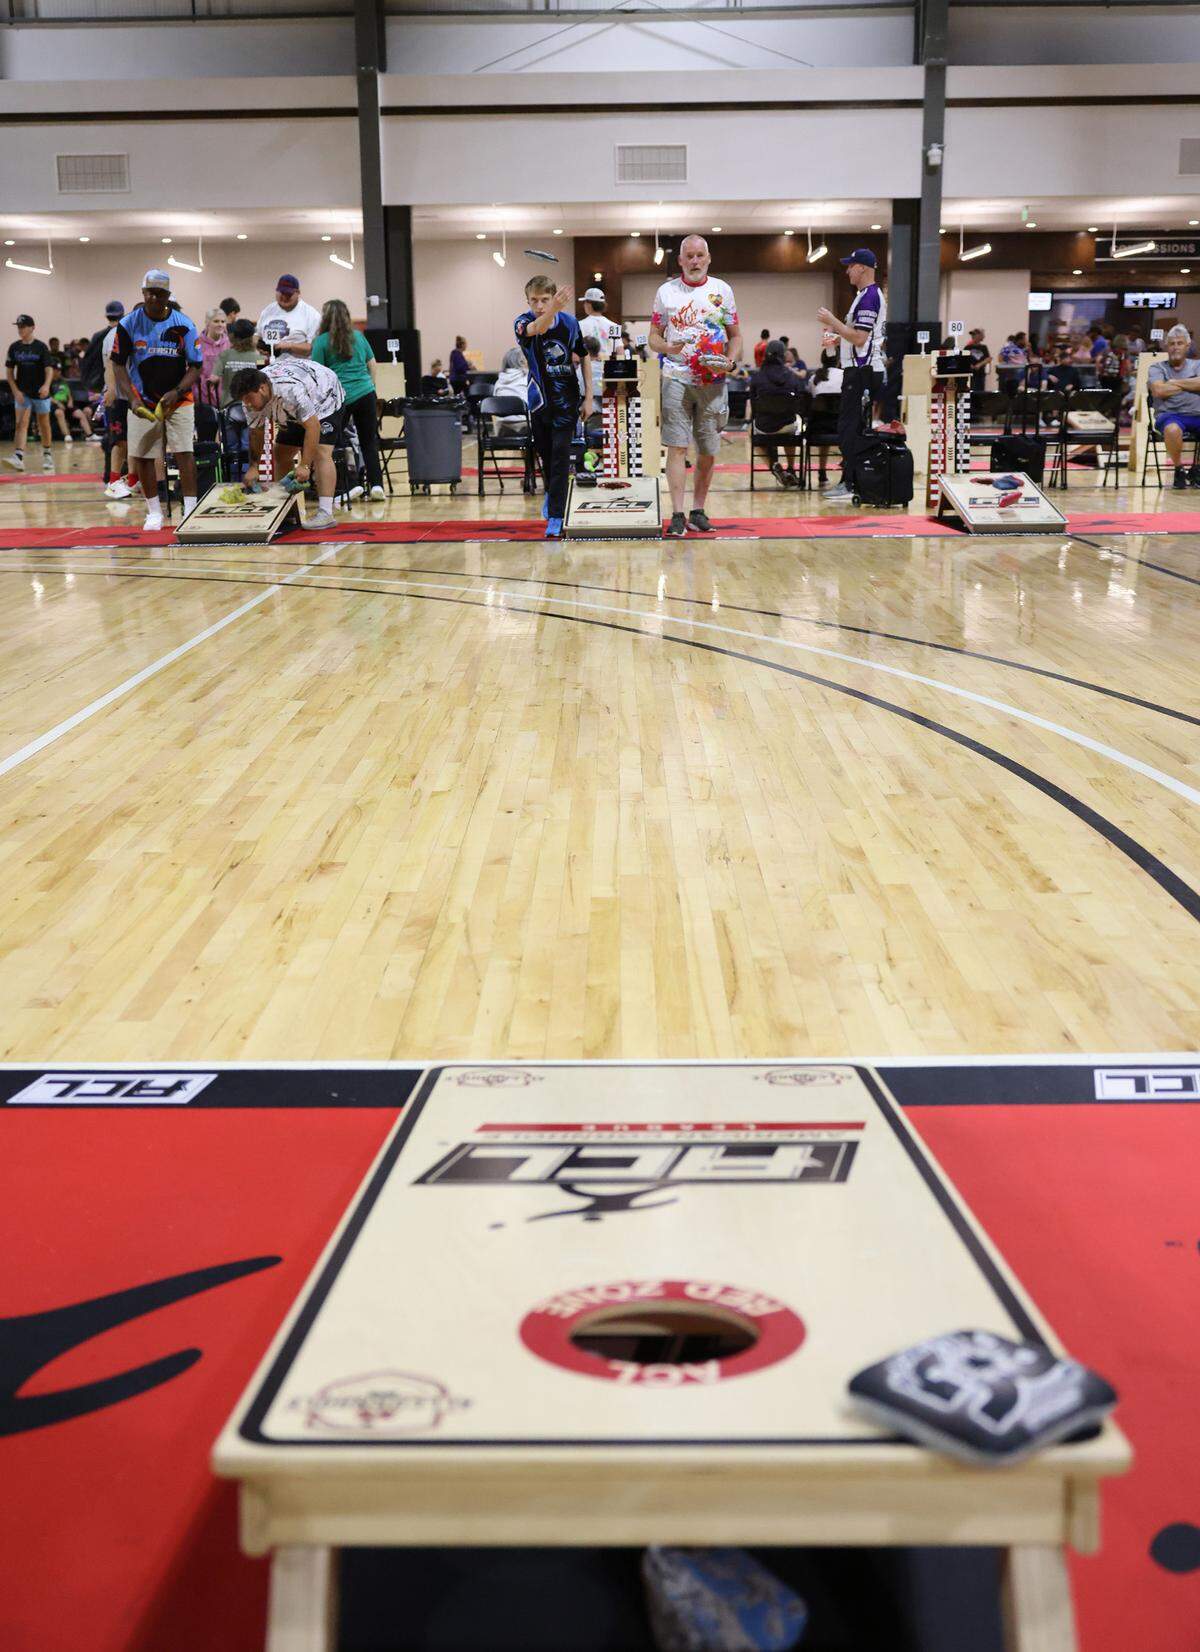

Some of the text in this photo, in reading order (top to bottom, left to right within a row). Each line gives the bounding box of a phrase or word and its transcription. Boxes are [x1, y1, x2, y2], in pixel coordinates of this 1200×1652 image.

[608, 326, 620, 336] 81
[951, 323, 963, 332] 80
[266, 330, 278, 340] 82
[45, 1079, 194, 1098] ACL
[467, 1144, 826, 1181] ACL
[606, 1358, 722, 1389] ACL
